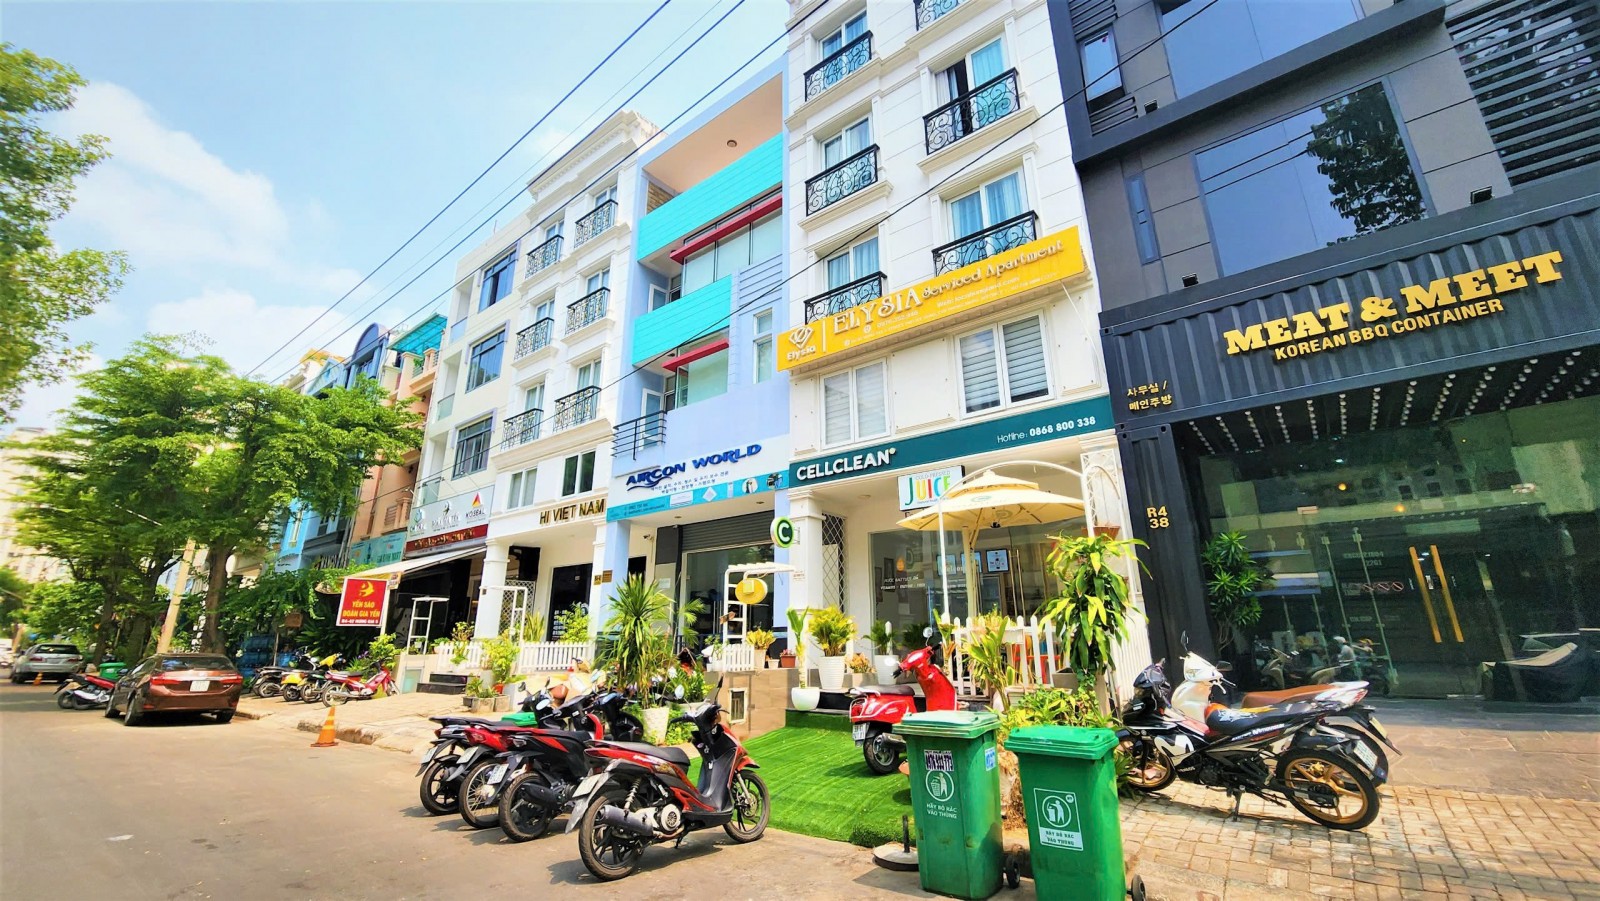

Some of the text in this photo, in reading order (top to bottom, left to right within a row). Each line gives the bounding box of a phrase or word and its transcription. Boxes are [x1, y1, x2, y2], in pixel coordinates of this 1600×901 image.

[832, 288, 924, 335] ELYSIA
[922, 267, 982, 299] Serviced
[985, 240, 1064, 278] Apartment
[1223, 251, 1563, 355] MEAT & MEET
[1275, 299, 1504, 360] KOREAN BBQ CONTAINER
[787, 345, 816, 361] Elysia
[1127, 382, 1159, 397] 사무실
[1128, 394, 1173, 411] 메인주방
[997, 416, 1096, 444] Hotline: 0868 800 338
[626, 444, 762, 486] AIRCON WORLD
[796, 449, 891, 481] CELLCLEAN
[905, 475, 951, 505] JUICE
[539, 510, 550, 524] HI
[553, 505, 577, 521] VIET
[579, 499, 605, 516] NAM
[1146, 506, 1168, 518] R4
[1149, 517, 1170, 529] 38
[927, 808, 938, 816] VÀO
[946, 804, 957, 813] RÁC
